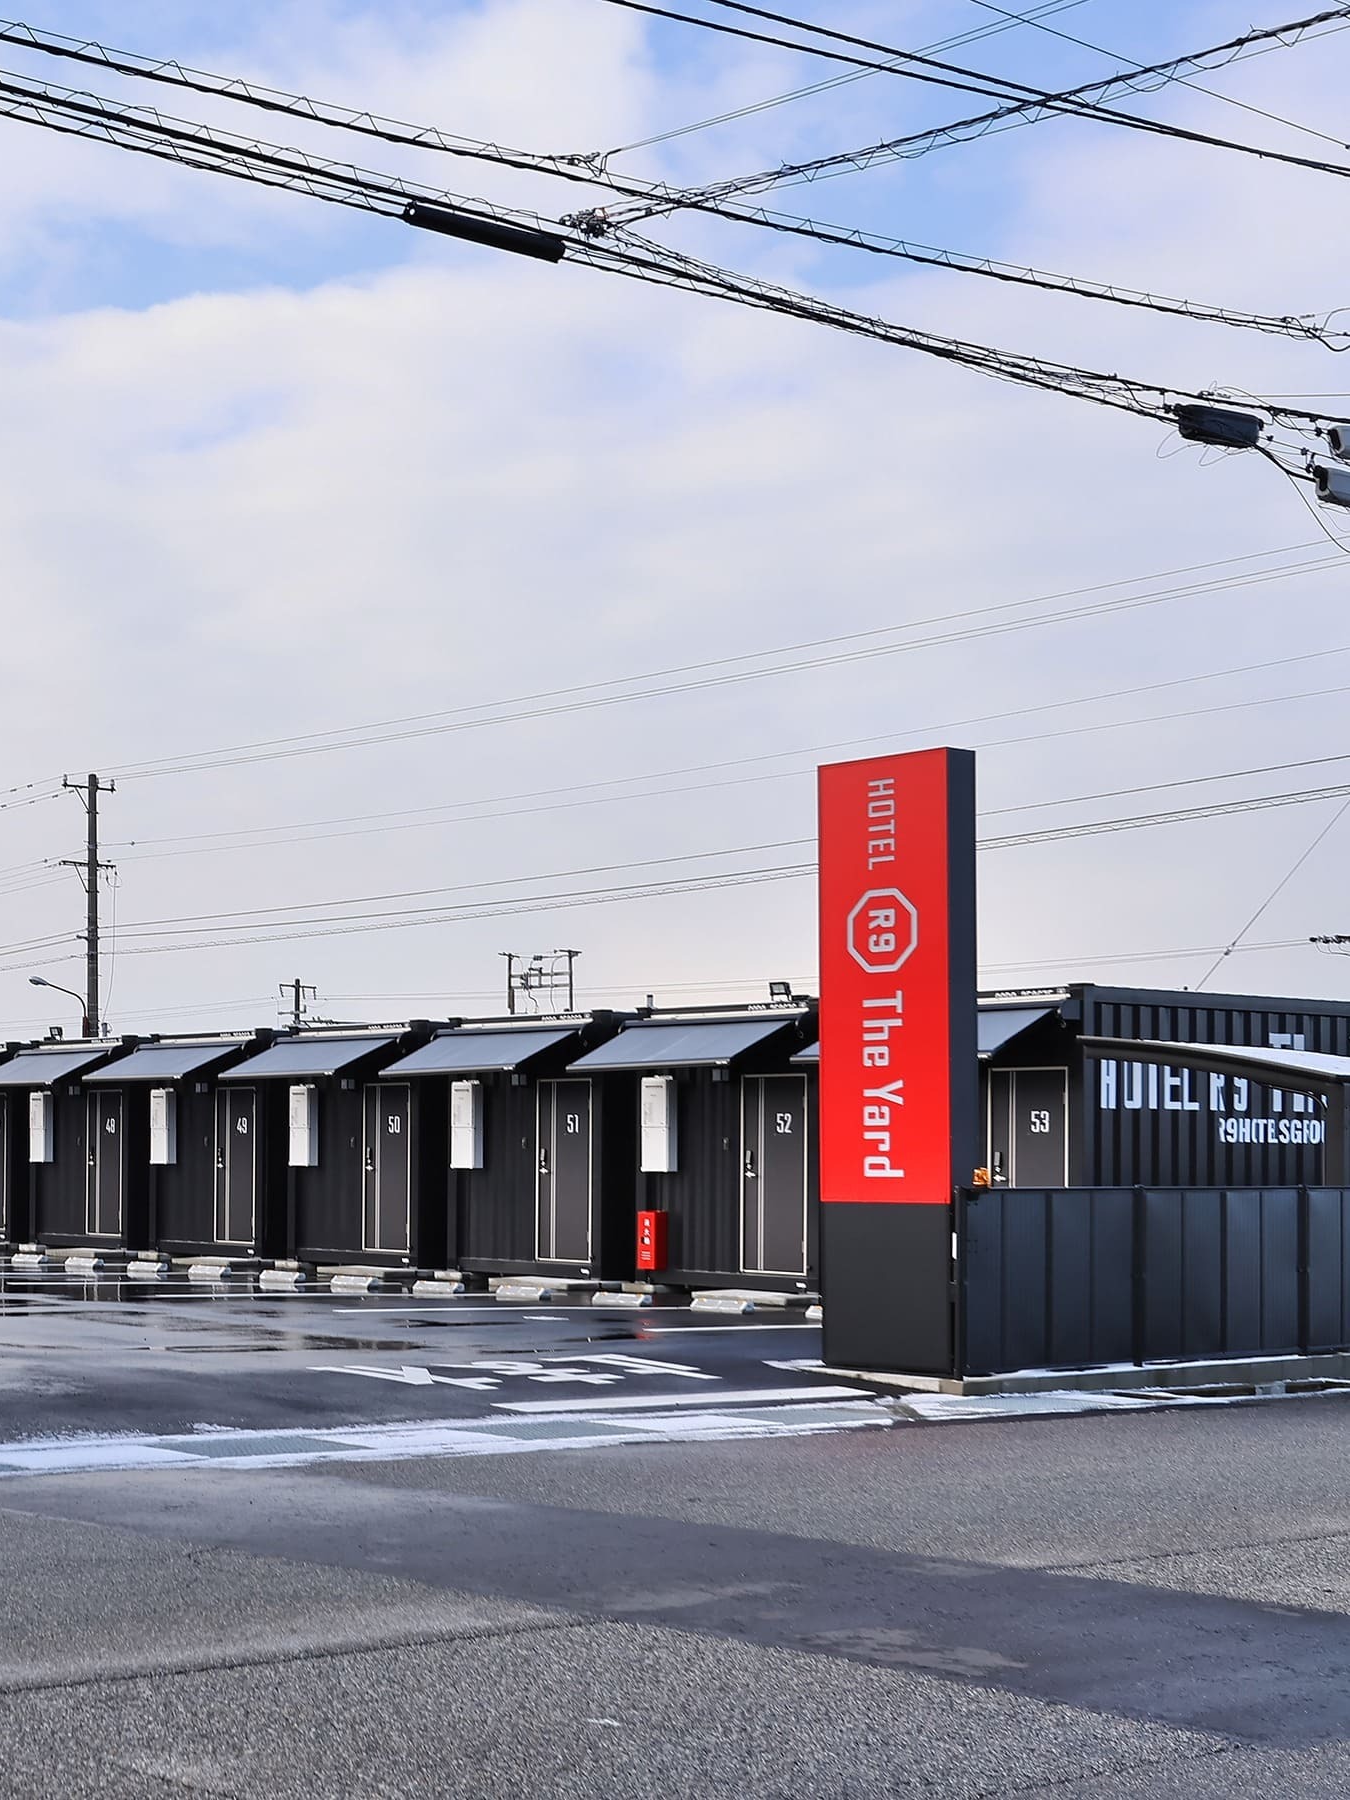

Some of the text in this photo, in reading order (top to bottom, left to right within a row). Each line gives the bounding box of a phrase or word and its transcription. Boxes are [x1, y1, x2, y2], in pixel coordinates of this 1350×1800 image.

[862, 777, 905, 1178] HOTEL R9 The Yard
[236, 1117, 248, 1134] 49
[388, 1115, 401, 1134] 50
[566, 1114, 579, 1133] 51
[776, 1113, 792, 1133] 52
[1030, 1110, 1050, 1133] 53
